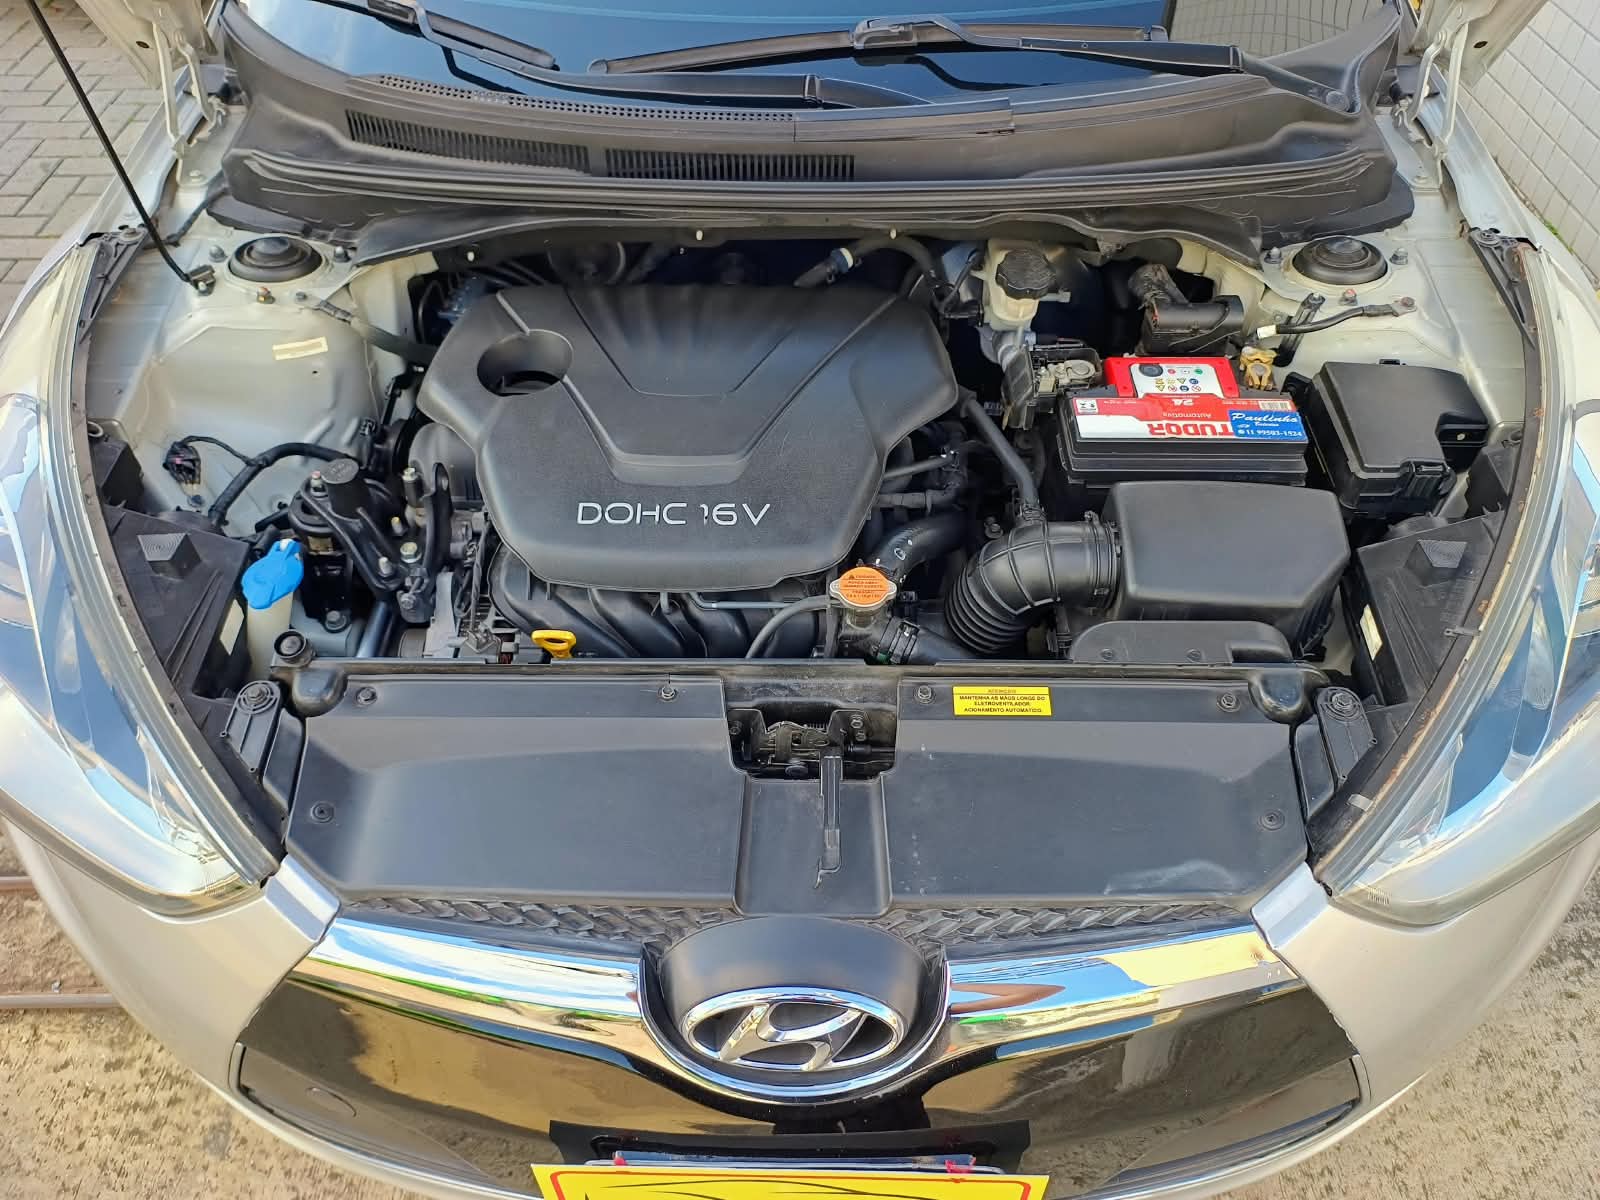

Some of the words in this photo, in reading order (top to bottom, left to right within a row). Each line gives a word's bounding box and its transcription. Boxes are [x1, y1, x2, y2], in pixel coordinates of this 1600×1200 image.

[1231, 412, 1298, 423] Paulinho
[1147, 422, 1234, 437] TUDOR
[577, 502, 688, 525] DOHC
[699, 502, 771, 526] 16V
